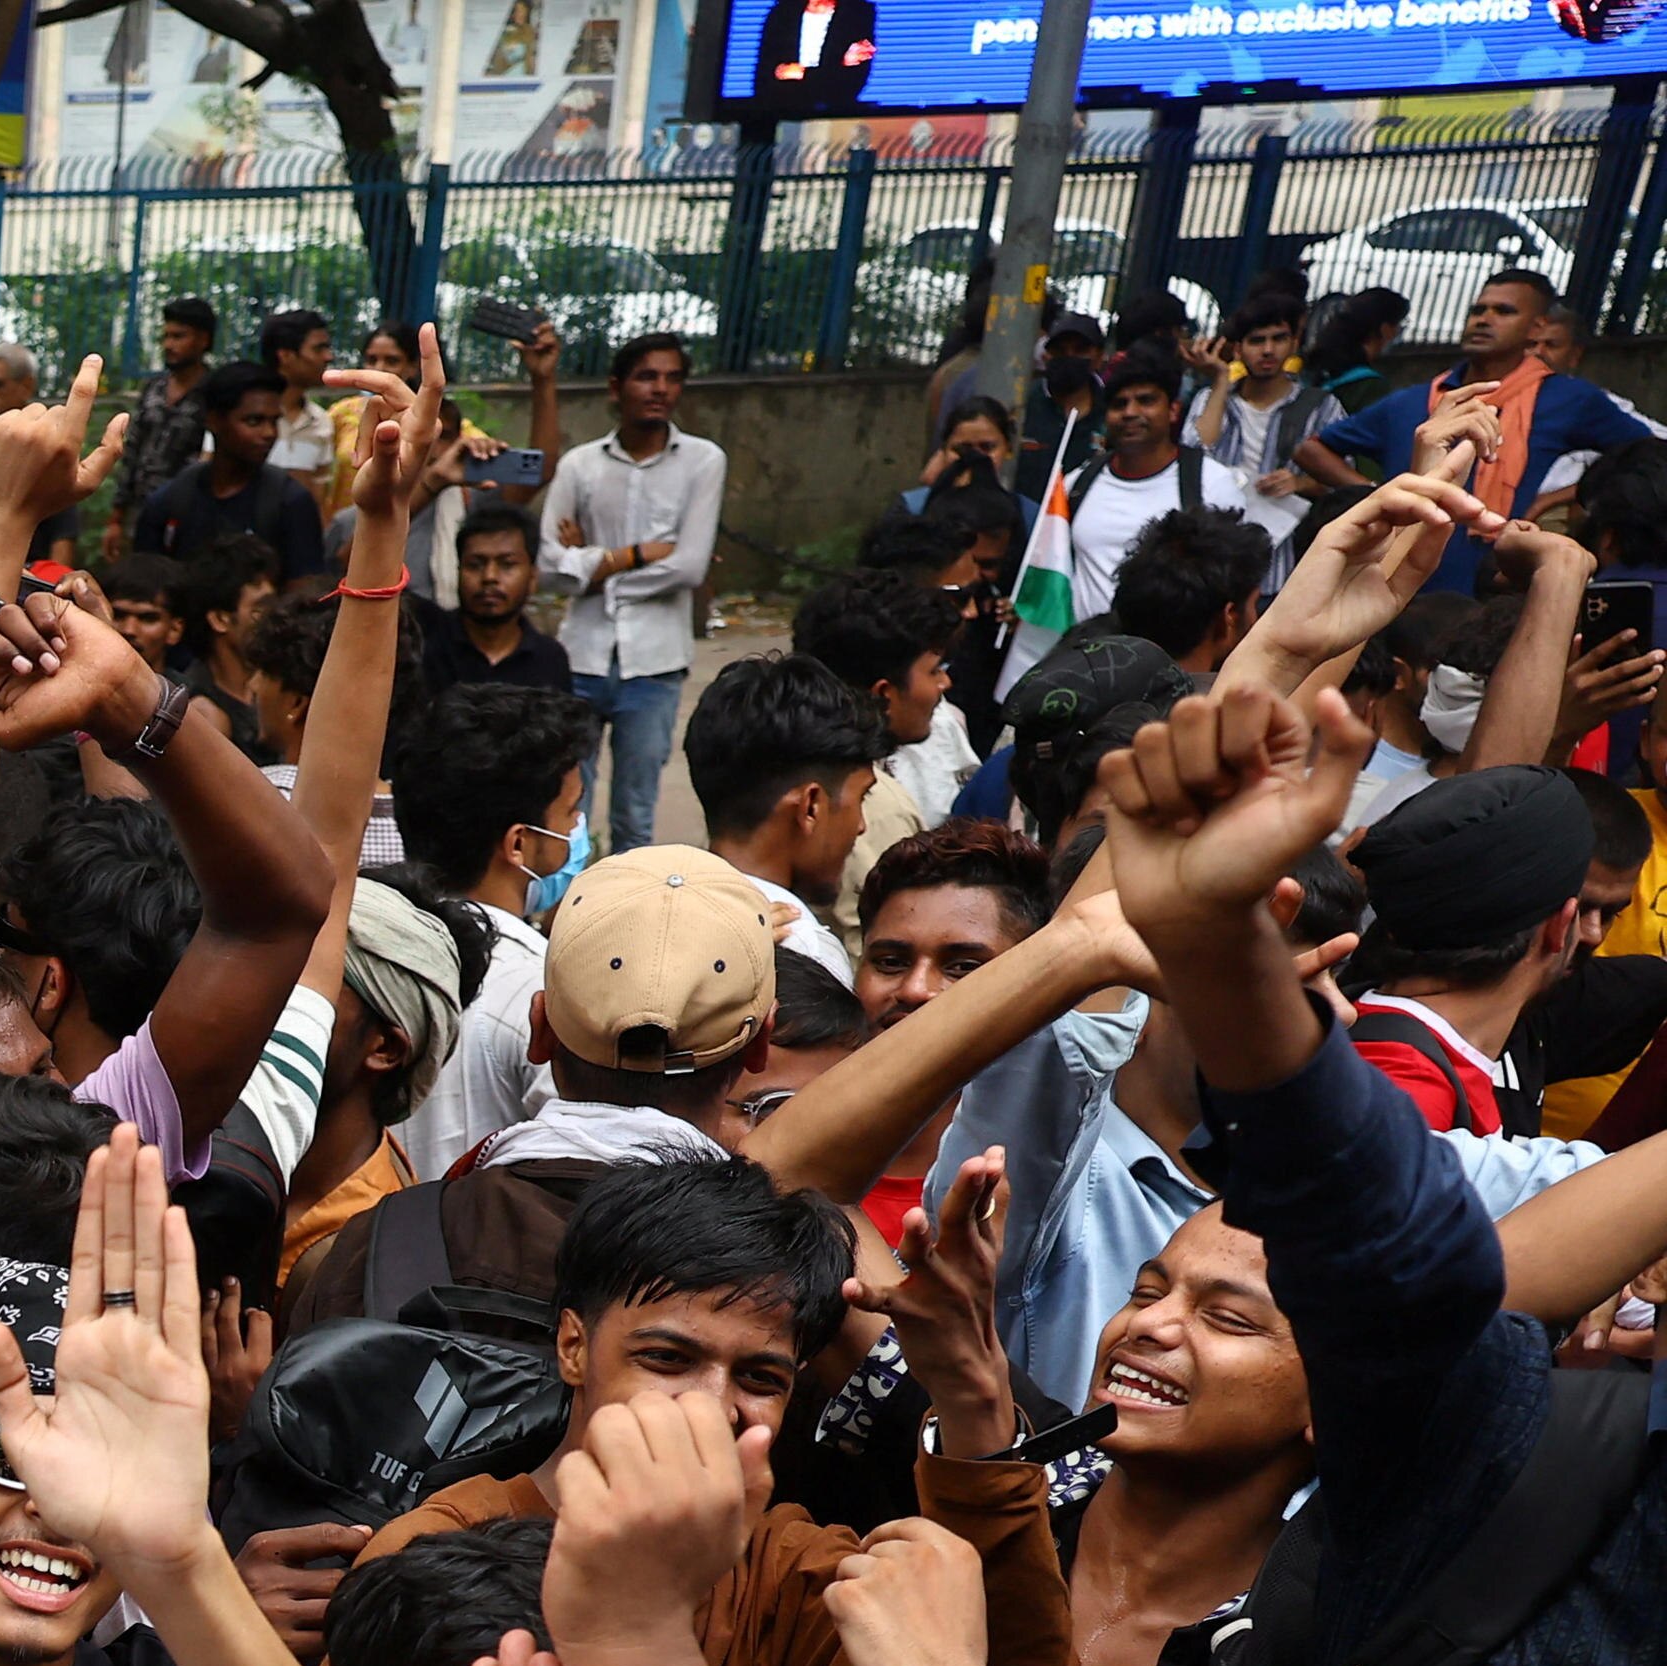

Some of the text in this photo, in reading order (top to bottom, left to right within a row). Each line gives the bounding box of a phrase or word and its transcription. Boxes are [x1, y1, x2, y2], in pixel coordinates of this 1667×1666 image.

[970, 0, 1531, 55] penners with exclusive benefits
[369, 1450, 409, 1484] TUF
